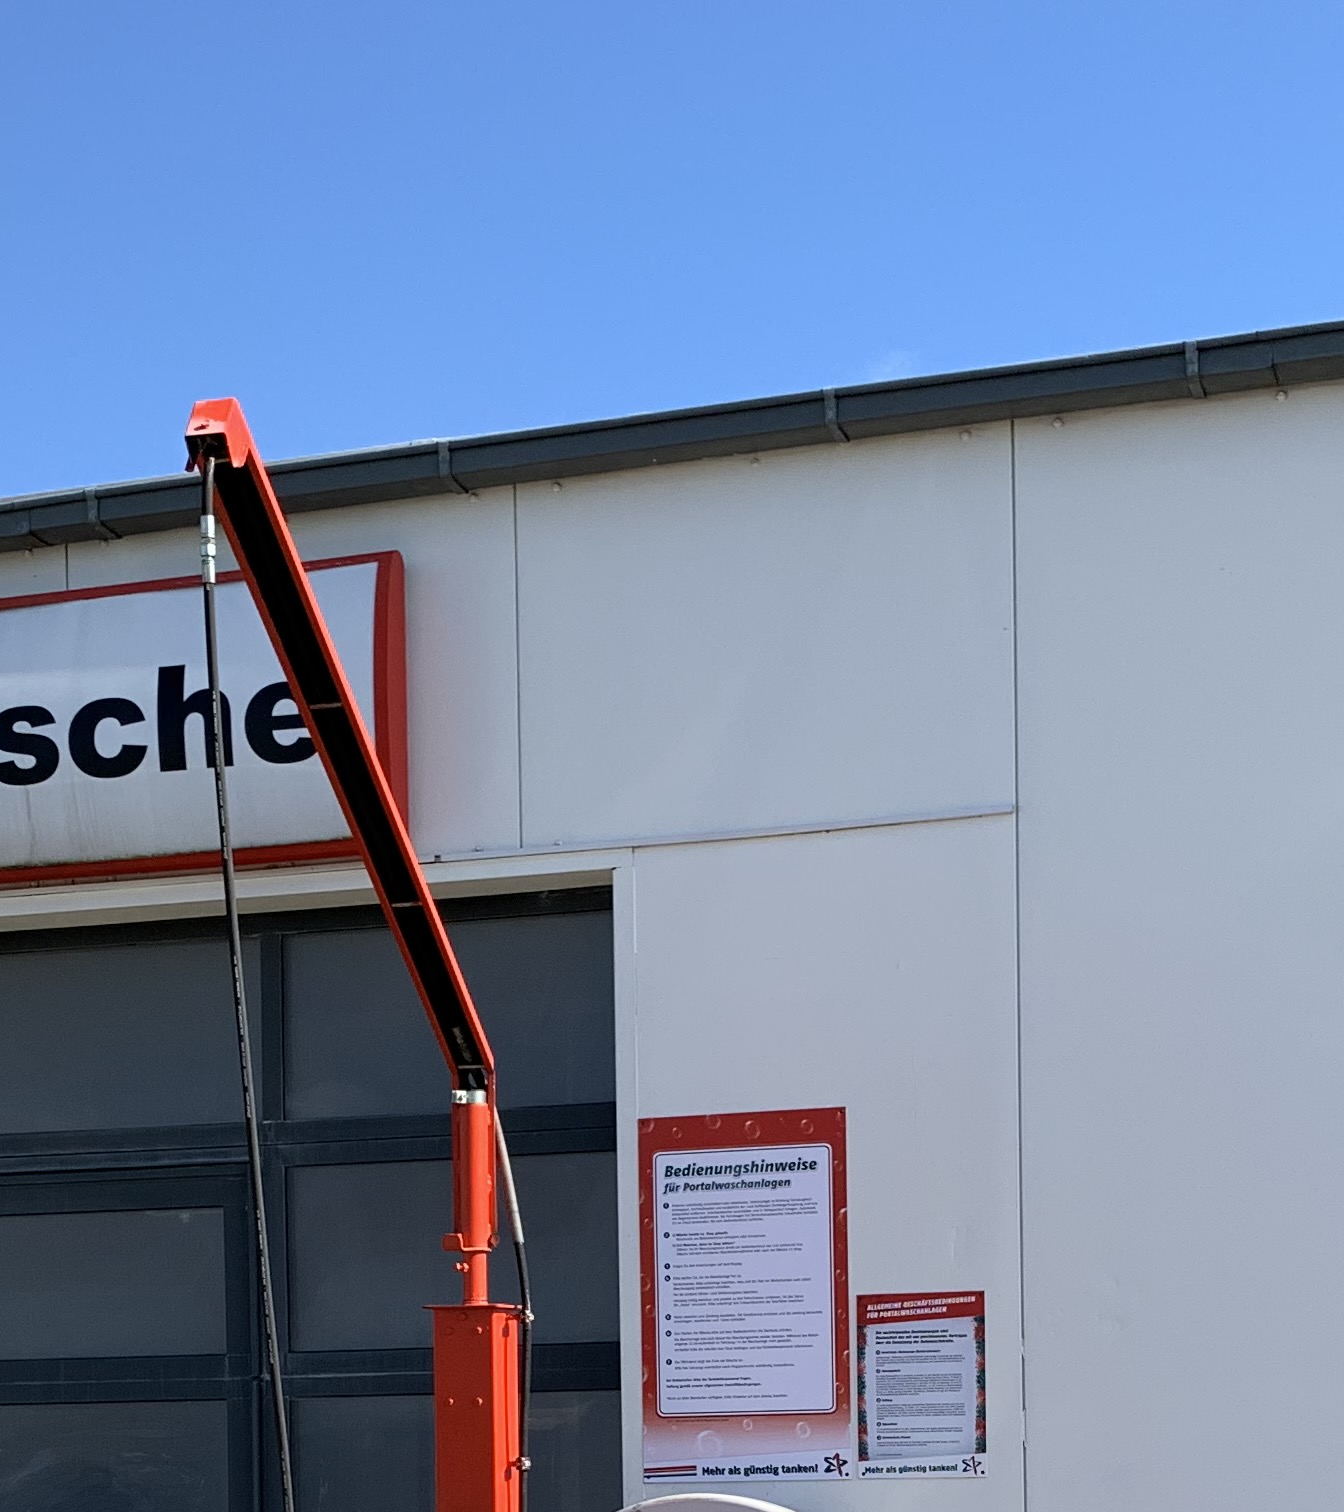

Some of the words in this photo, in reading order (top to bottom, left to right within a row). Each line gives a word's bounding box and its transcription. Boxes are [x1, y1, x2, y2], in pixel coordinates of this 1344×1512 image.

[664, 1157, 818, 1178] Bedienungshinweise
[663, 1183, 680, 1195] für
[682, 1178, 791, 1192] Portalwaschanlagen
[701, 1466, 726, 1476] Mehr
[728, 1465, 742, 1475] als
[744, 1464, 779, 1477] günstig
[781, 1463, 818, 1474] tanken!
[864, 1466, 884, 1475] Mehr
[885, 1465, 897, 1473] als
[898, 1464, 927, 1475] günstig
[928, 1463, 958, 1472] tanken!
